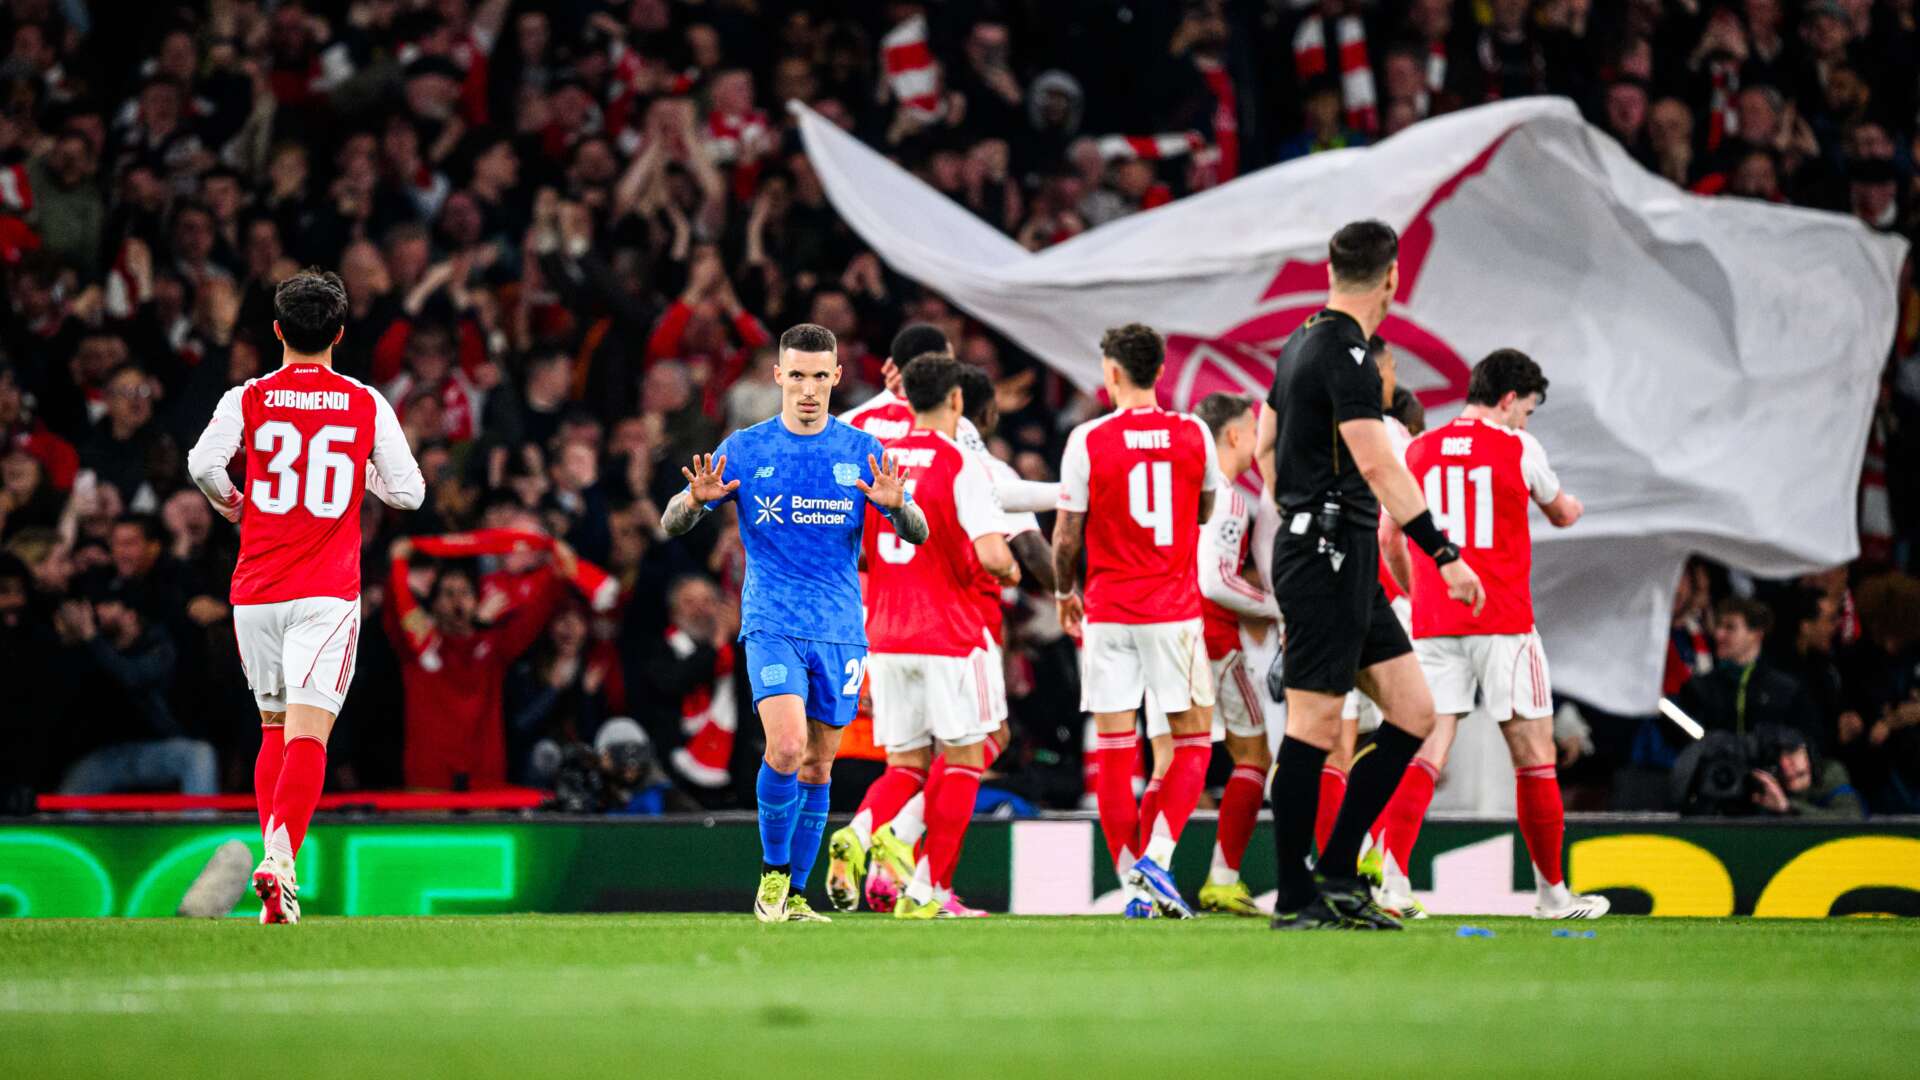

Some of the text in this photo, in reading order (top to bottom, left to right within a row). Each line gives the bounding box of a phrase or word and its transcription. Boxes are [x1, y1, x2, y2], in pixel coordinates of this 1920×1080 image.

[264, 390, 349, 411] ZUBIMENDI
[1123, 429, 1171, 449] WHITE
[1441, 437, 1473, 456] RICE
[252, 421, 356, 518] 36
[791, 495, 854, 511] Barmenia
[1128, 461, 1173, 546] 4
[1424, 465, 1494, 549] 41
[791, 511, 846, 524] Gothaer
